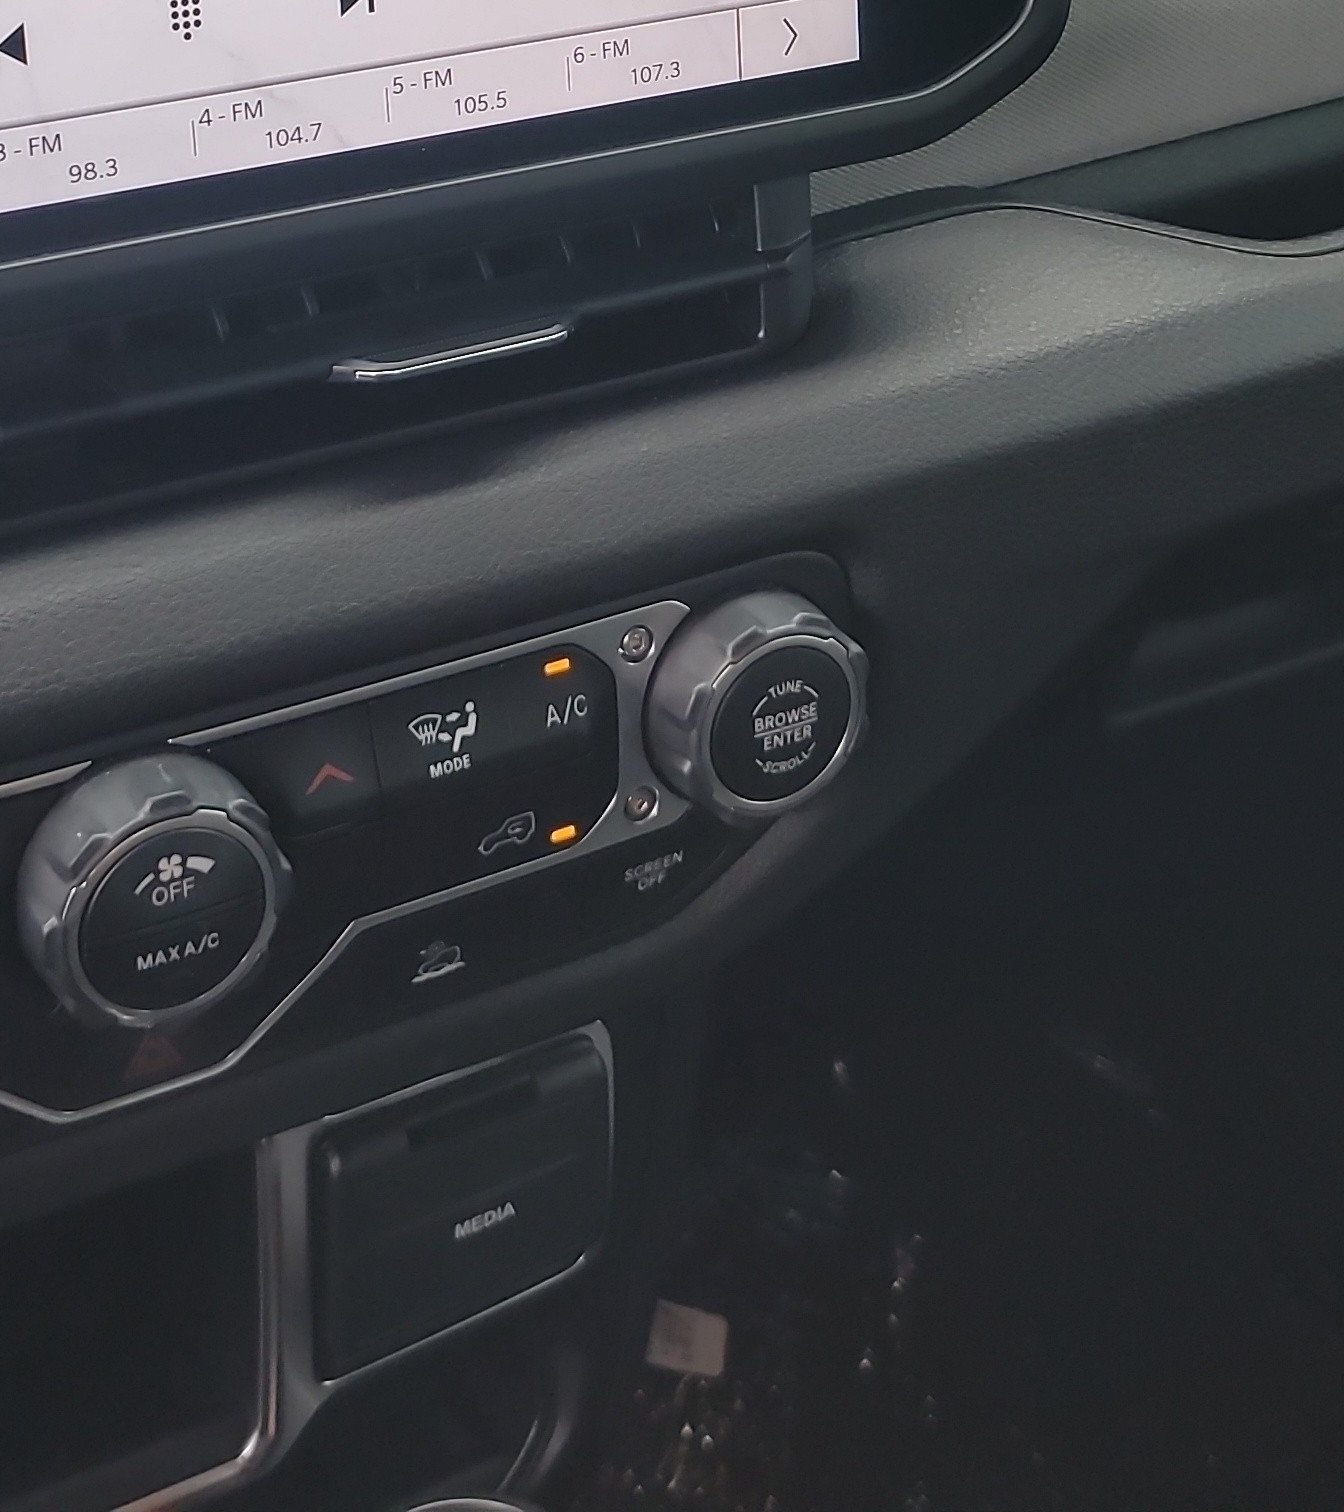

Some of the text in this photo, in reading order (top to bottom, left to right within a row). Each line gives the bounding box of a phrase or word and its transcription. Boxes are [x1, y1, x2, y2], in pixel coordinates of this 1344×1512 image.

[572, 43, 586, 63] 6
[600, 37, 630, 59] FM
[391, 74, 405, 95] 5
[421, 67, 453, 89] FM
[629, 60, 681, 86] 107.3
[198, 108, 214, 130] 4
[230, 99, 264, 122] FM
[453, 90, 508, 117] 105.5
[28, 133, 64, 155] FM
[263, 122, 323, 151] 104.7
[67, 158, 119, 185] 98.3
[768, 679, 804, 698] TUNE
[545, 694, 588, 729] A/C
[754, 701, 817, 733] BROWSE
[763, 724, 812, 751] ENTER
[428, 754, 473, 779] MODE
[150, 877, 195, 907] OFF
[136, 931, 221, 971] MAX A/C
[455, 1201, 516, 1239] MEDIA
